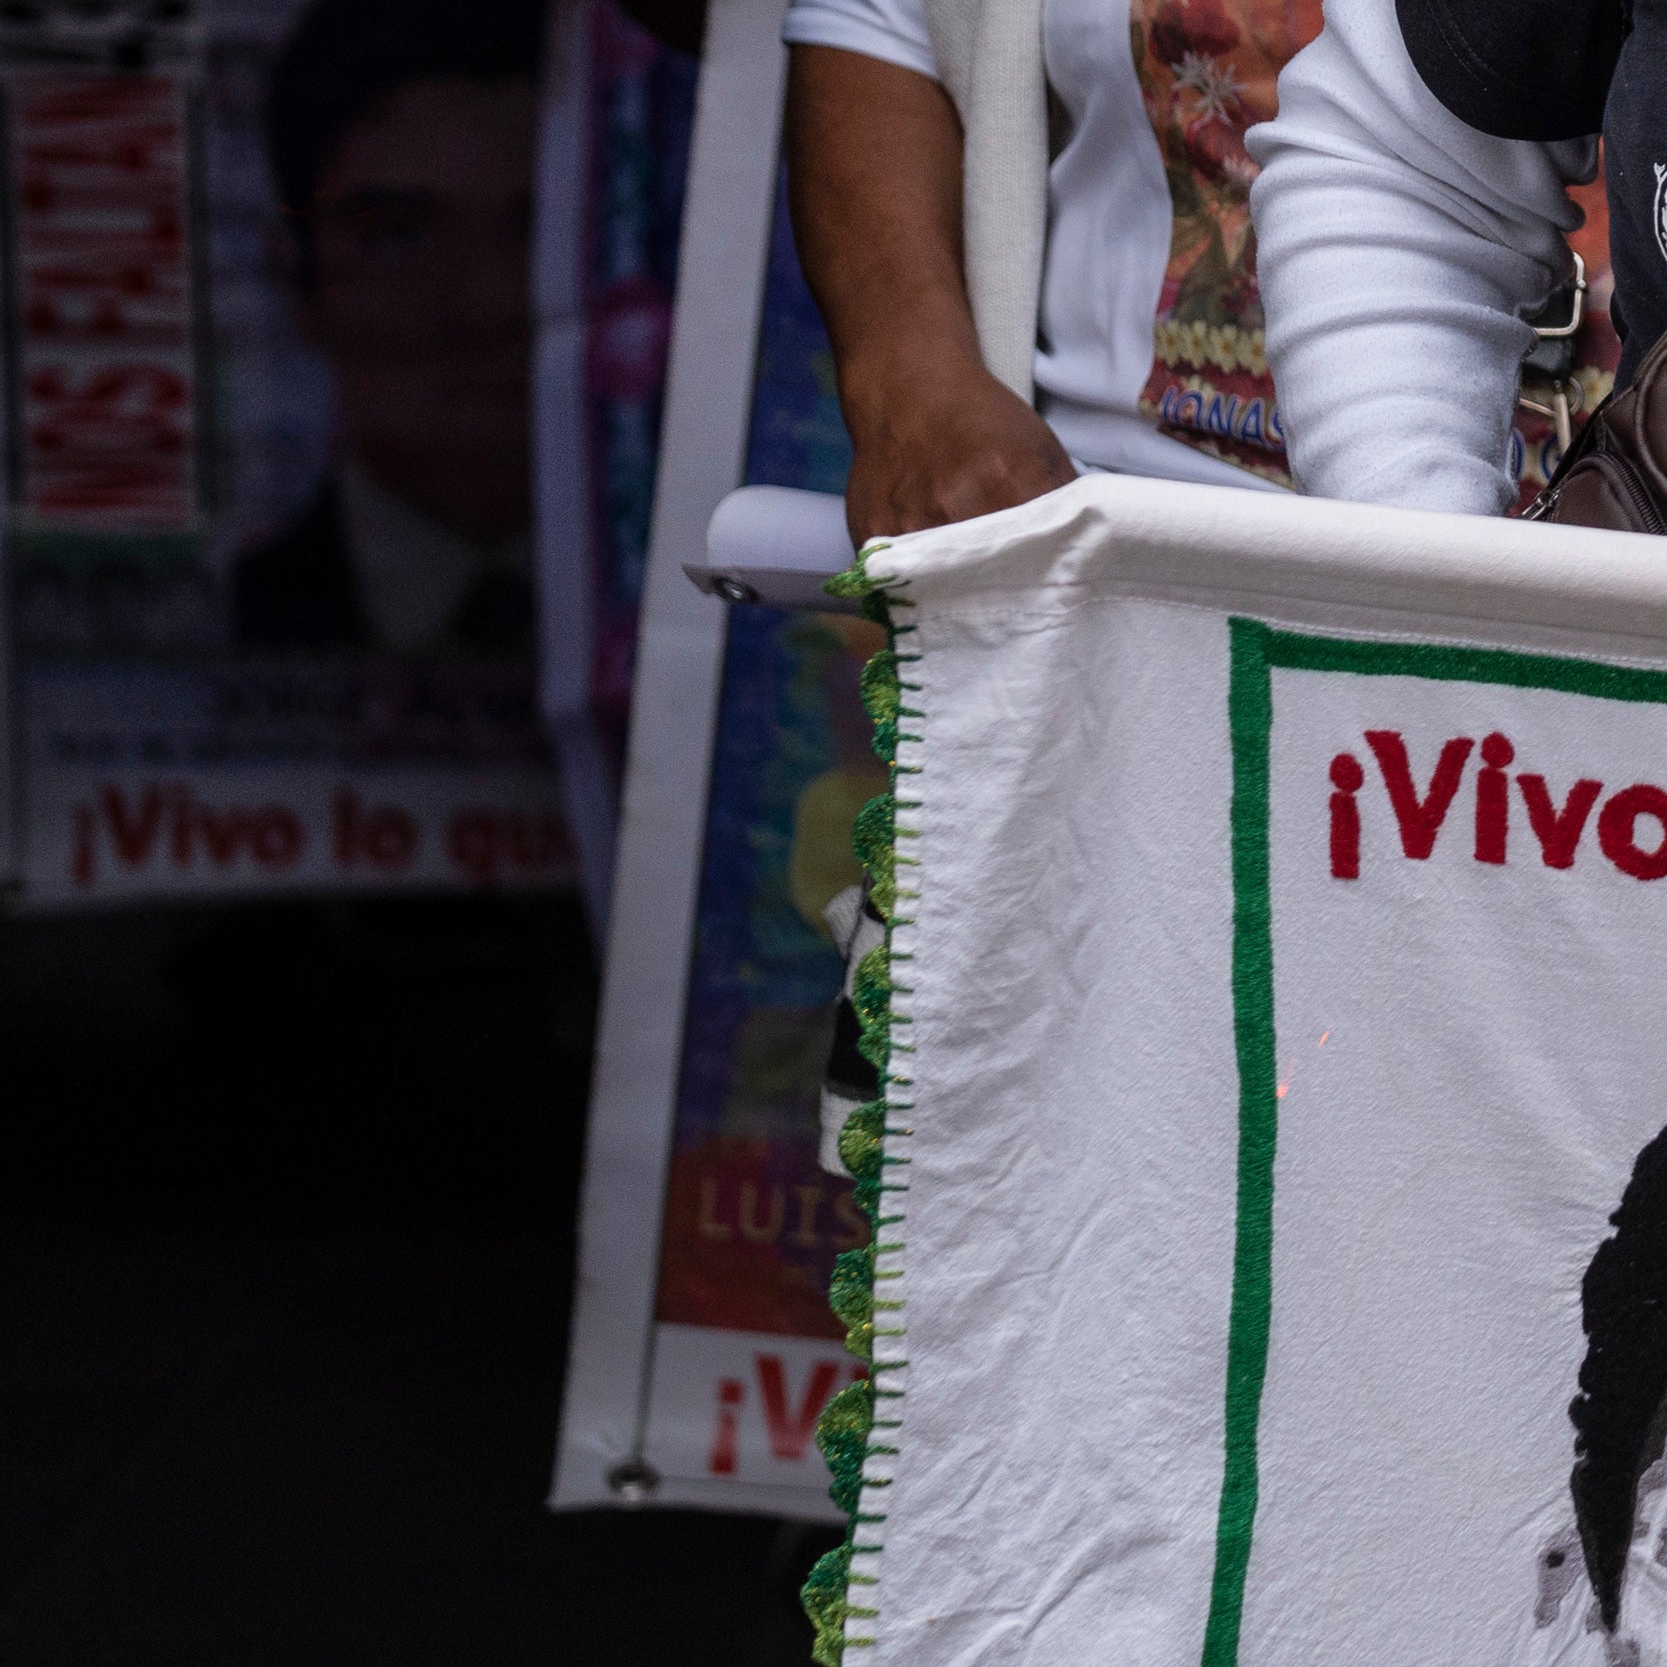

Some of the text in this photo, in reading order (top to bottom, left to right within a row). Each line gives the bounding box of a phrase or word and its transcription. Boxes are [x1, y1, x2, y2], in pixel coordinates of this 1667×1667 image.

[70, 781, 580, 890] ¡Vivo lo qu
